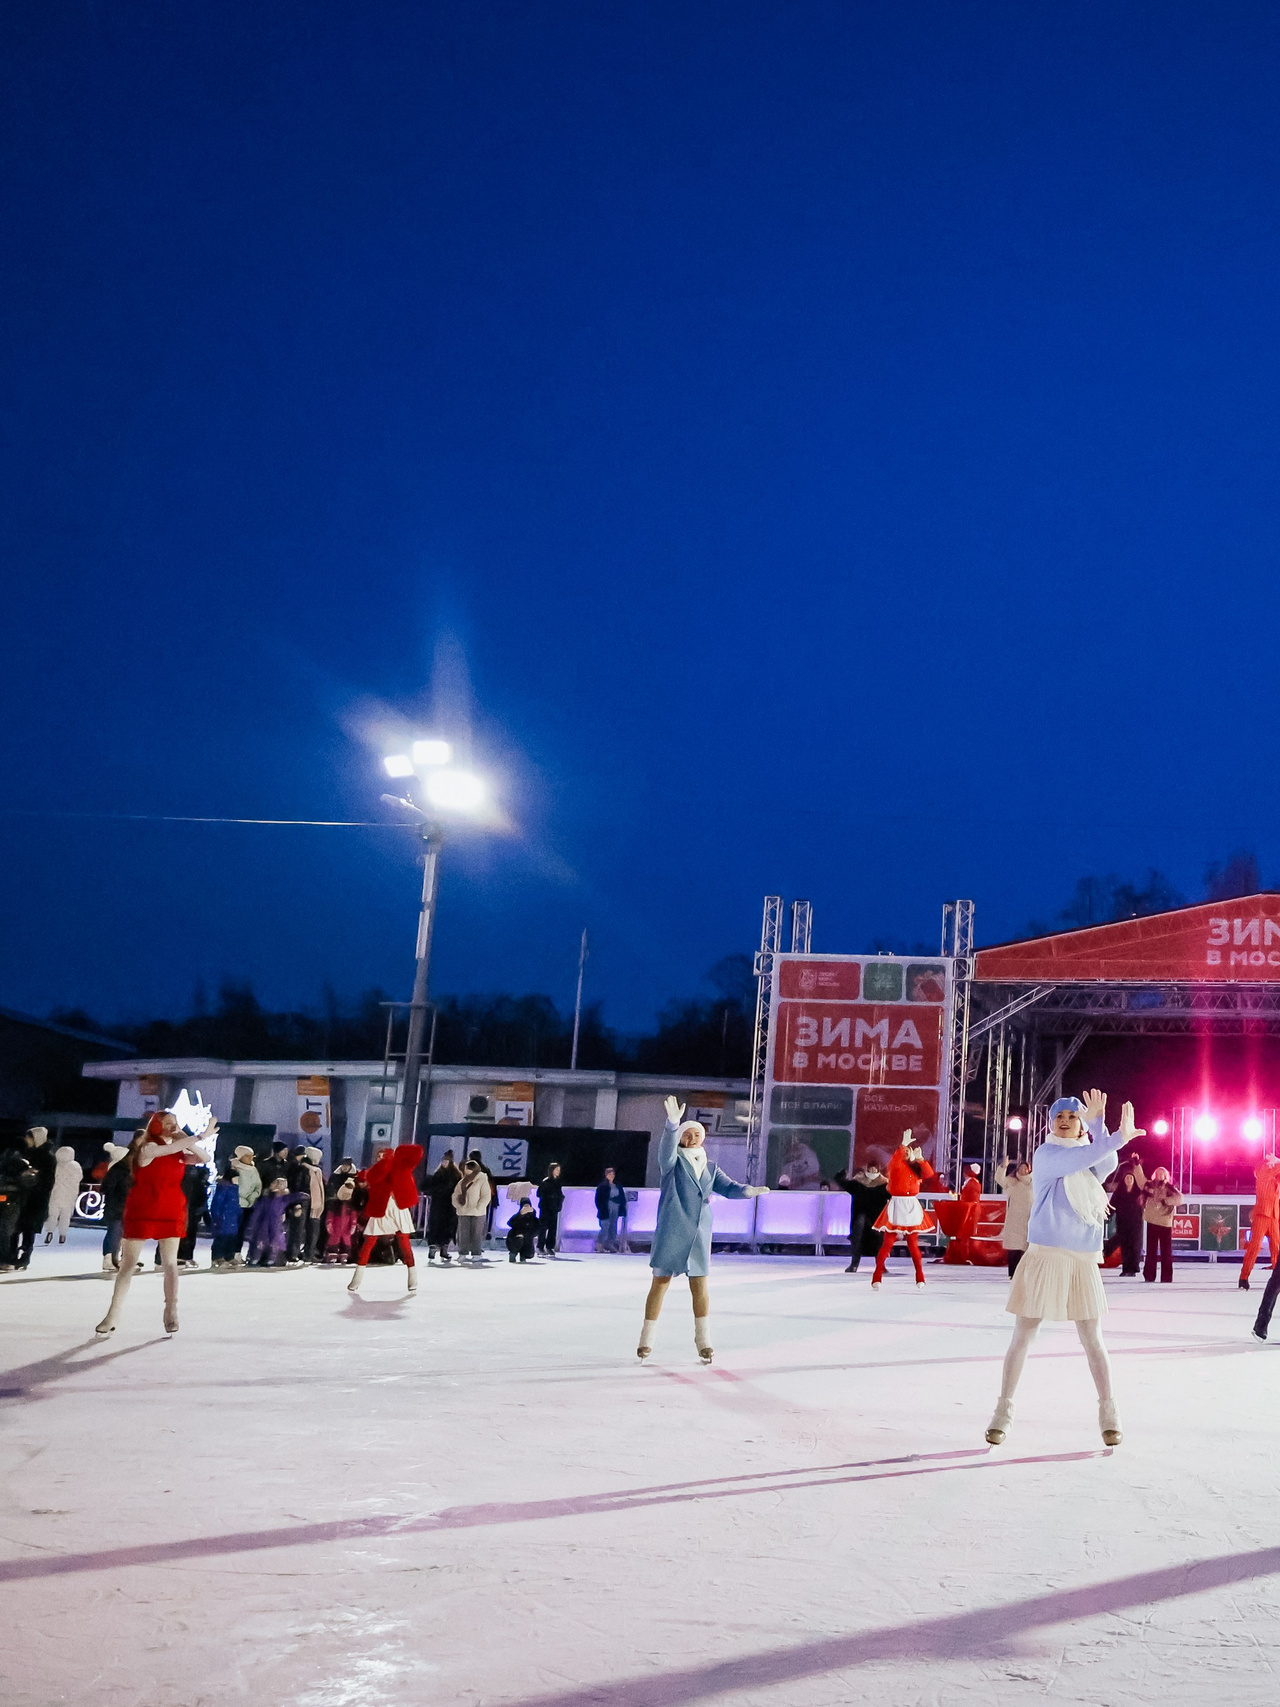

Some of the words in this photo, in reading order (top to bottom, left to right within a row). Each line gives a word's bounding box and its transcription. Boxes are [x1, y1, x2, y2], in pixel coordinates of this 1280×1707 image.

[1206, 950, 1221, 966] В
[794, 1016, 924, 1050] ЗИМА
[793, 1051, 809, 1069] В
[817, 1053, 924, 1072] МОСКВЕ
[1173, 1219, 1193, 1229] МА
